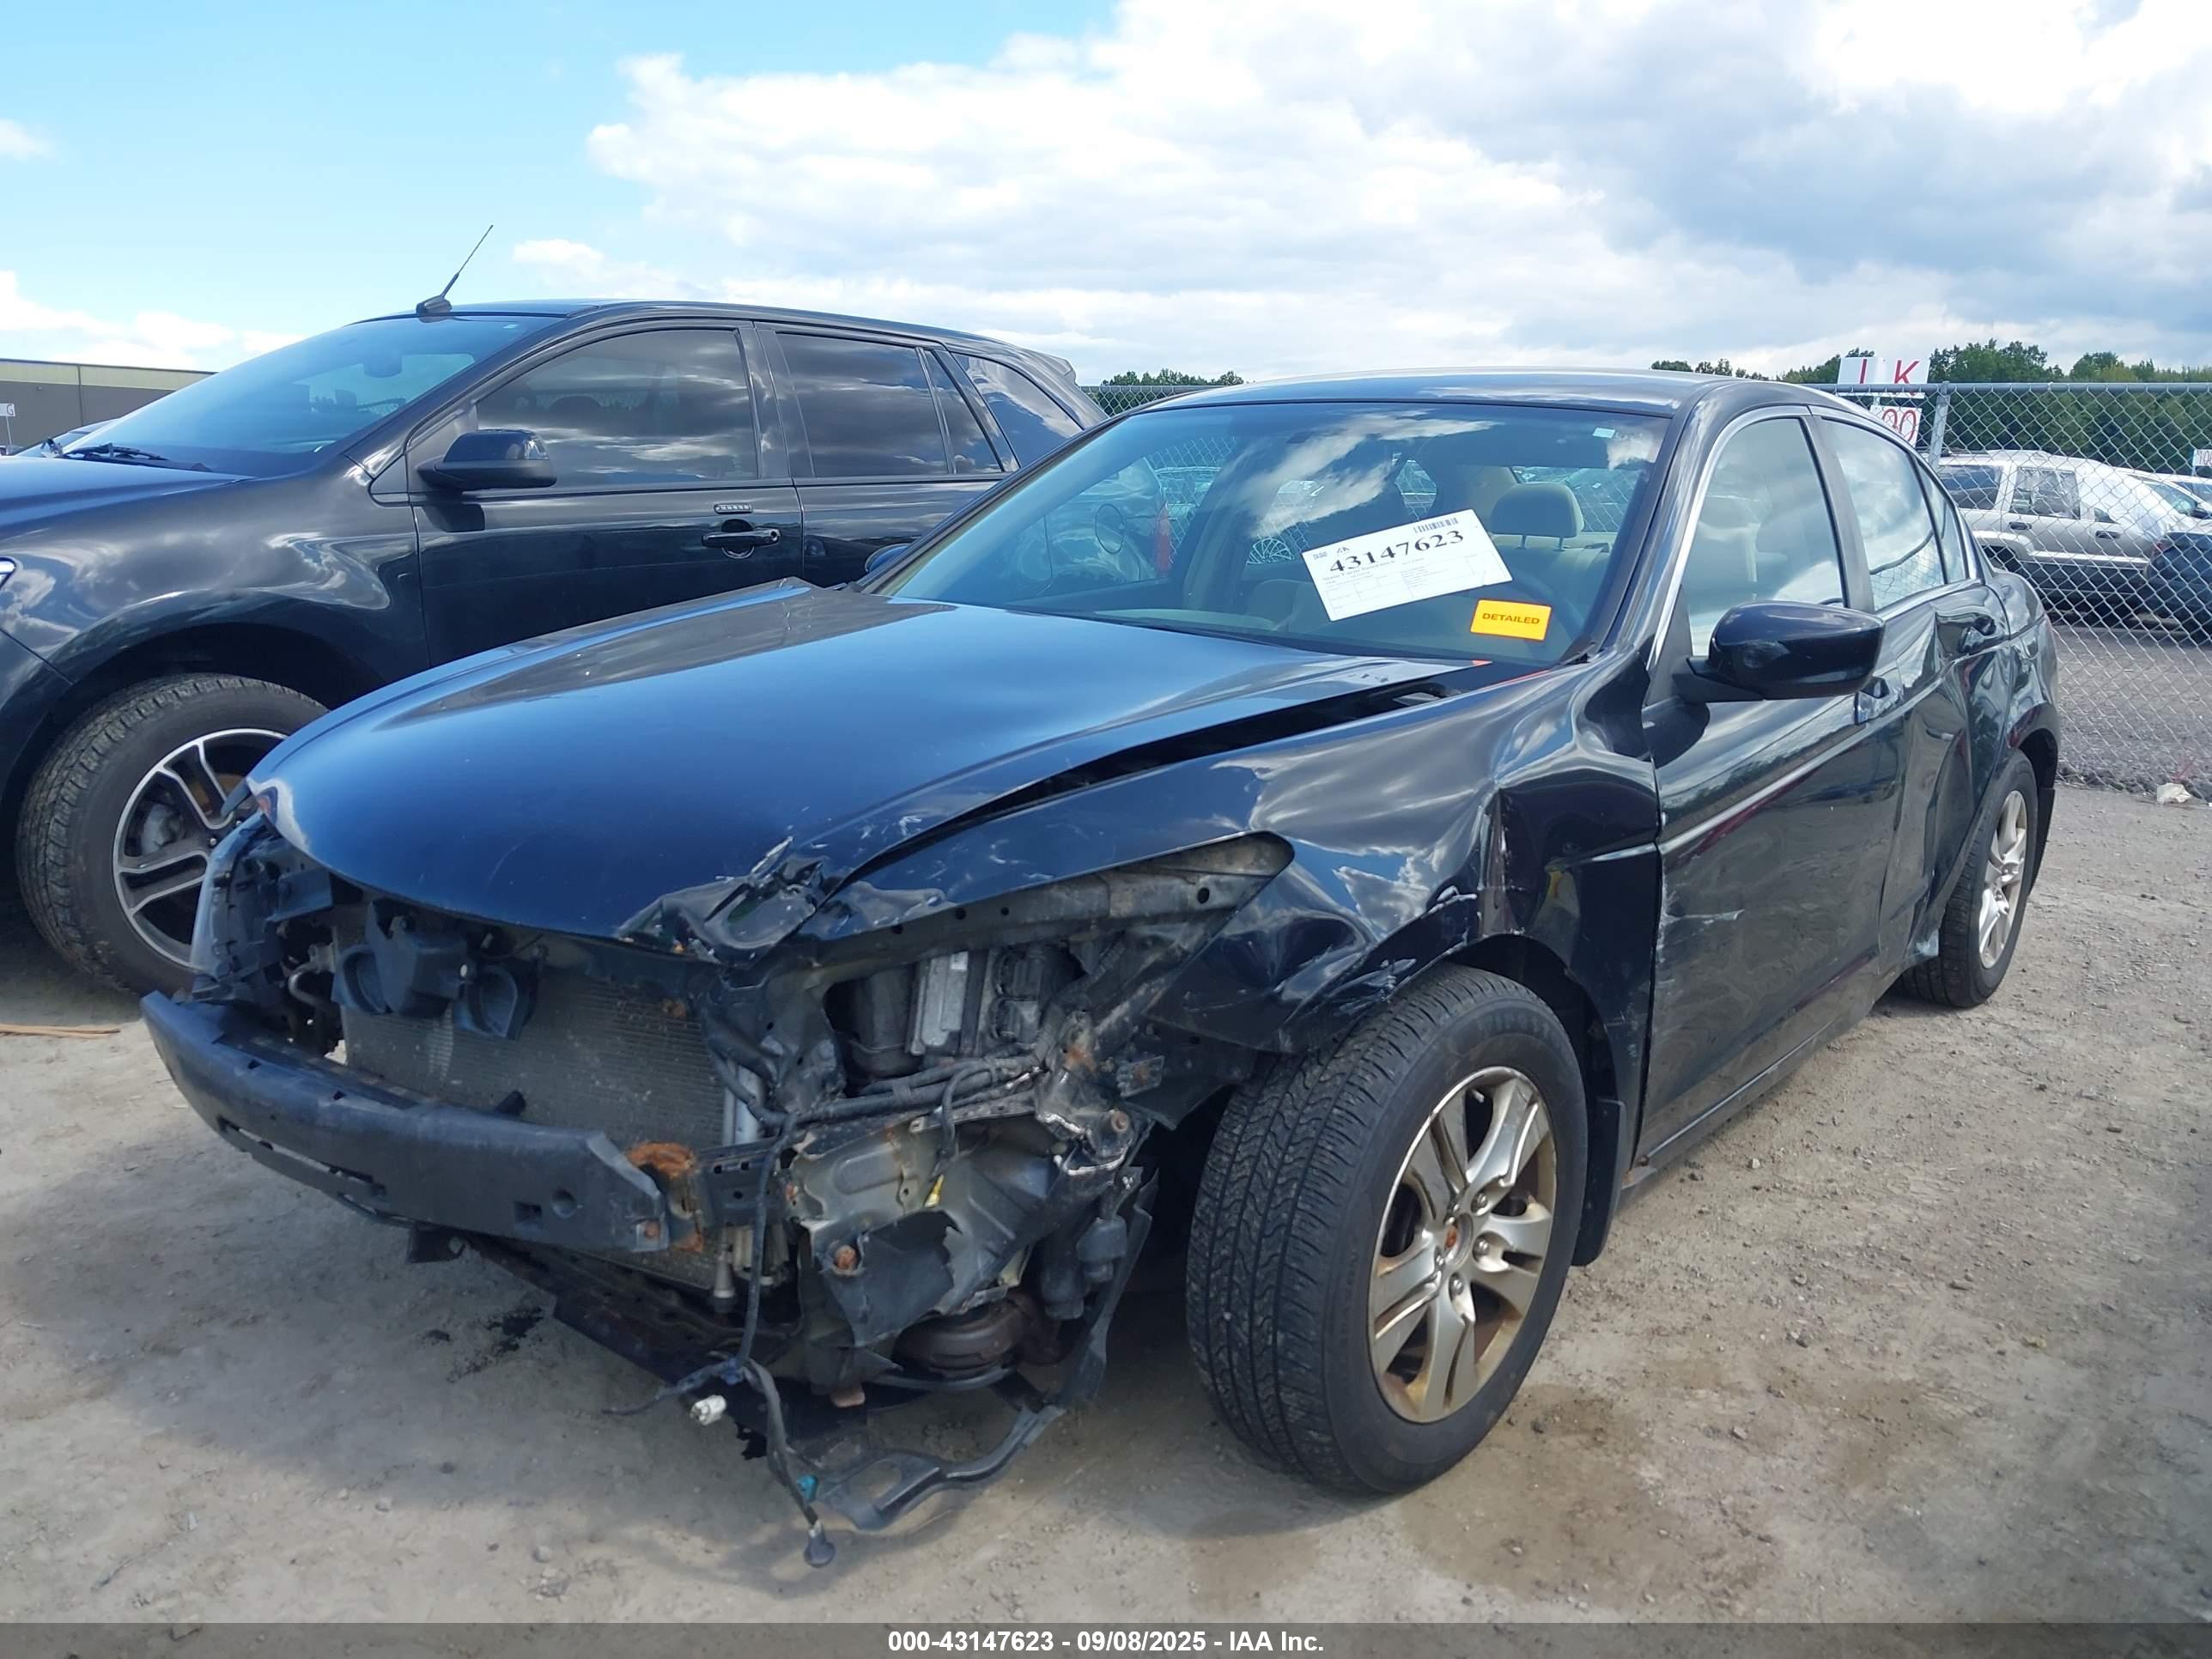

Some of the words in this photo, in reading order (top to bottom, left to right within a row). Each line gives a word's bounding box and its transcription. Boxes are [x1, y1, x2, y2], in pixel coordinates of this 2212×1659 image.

[1893, 359, 1920, 397] K
[1329, 529, 1465, 573] 43147623
[1482, 612, 1540, 624] DETAILED
